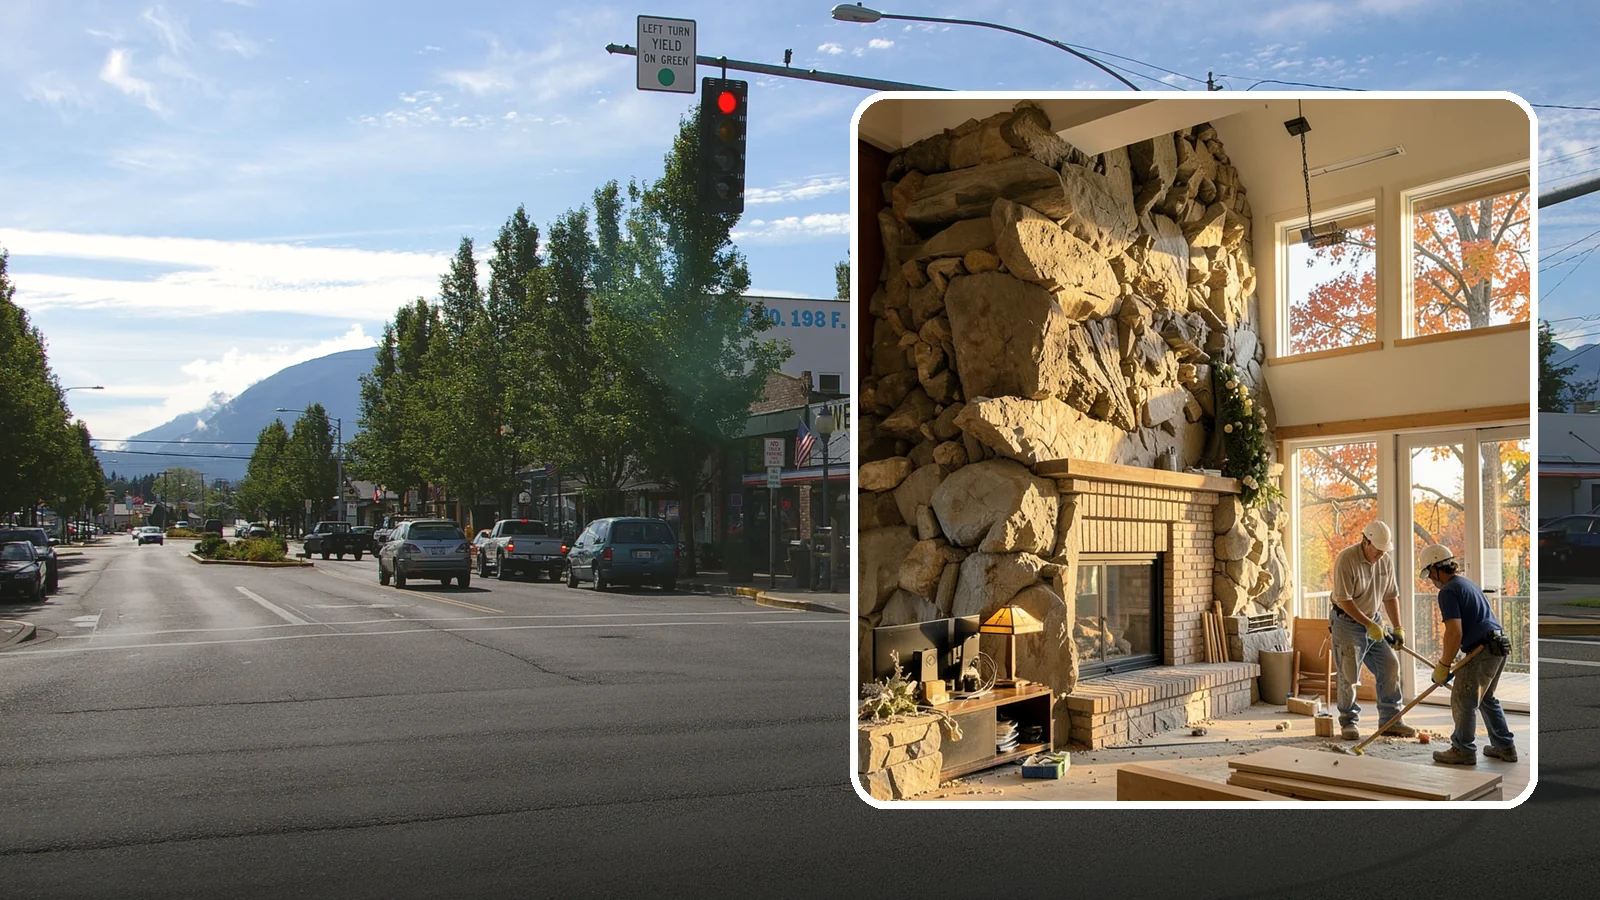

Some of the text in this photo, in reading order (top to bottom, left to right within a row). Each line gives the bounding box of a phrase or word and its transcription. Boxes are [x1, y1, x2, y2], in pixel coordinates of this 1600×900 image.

[643, 24, 690, 36] LEFT TURN
[652, 37, 682, 52] YIELD
[644, 53, 689, 66] ON GREEN
[791, 309, 826, 328] 198
[831, 311, 847, 329] F.
